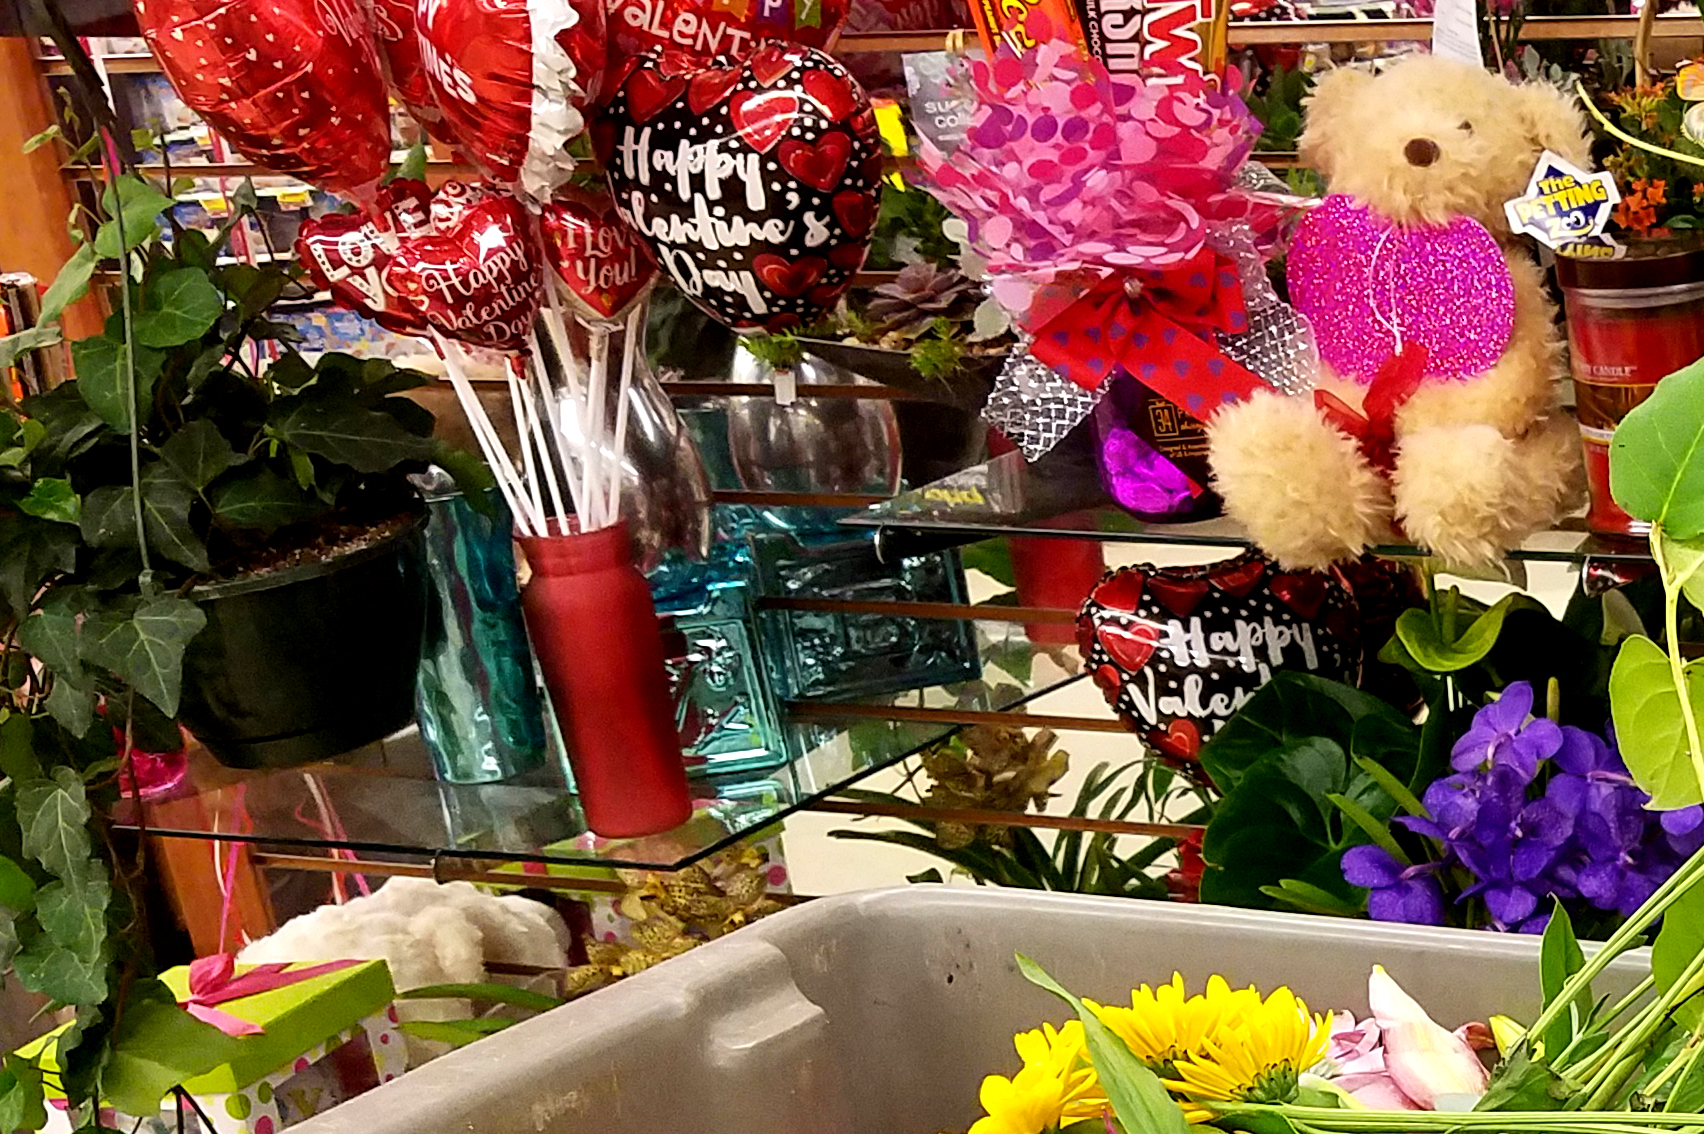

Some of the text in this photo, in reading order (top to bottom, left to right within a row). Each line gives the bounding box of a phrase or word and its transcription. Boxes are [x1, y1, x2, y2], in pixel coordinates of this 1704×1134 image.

[616, 125, 767, 211] Happy
[1514, 179, 1608, 227] PETTING
[421, 239, 530, 304] Happy
[656, 243, 768, 314] Day
[1158, 615, 1319, 675] Happy
